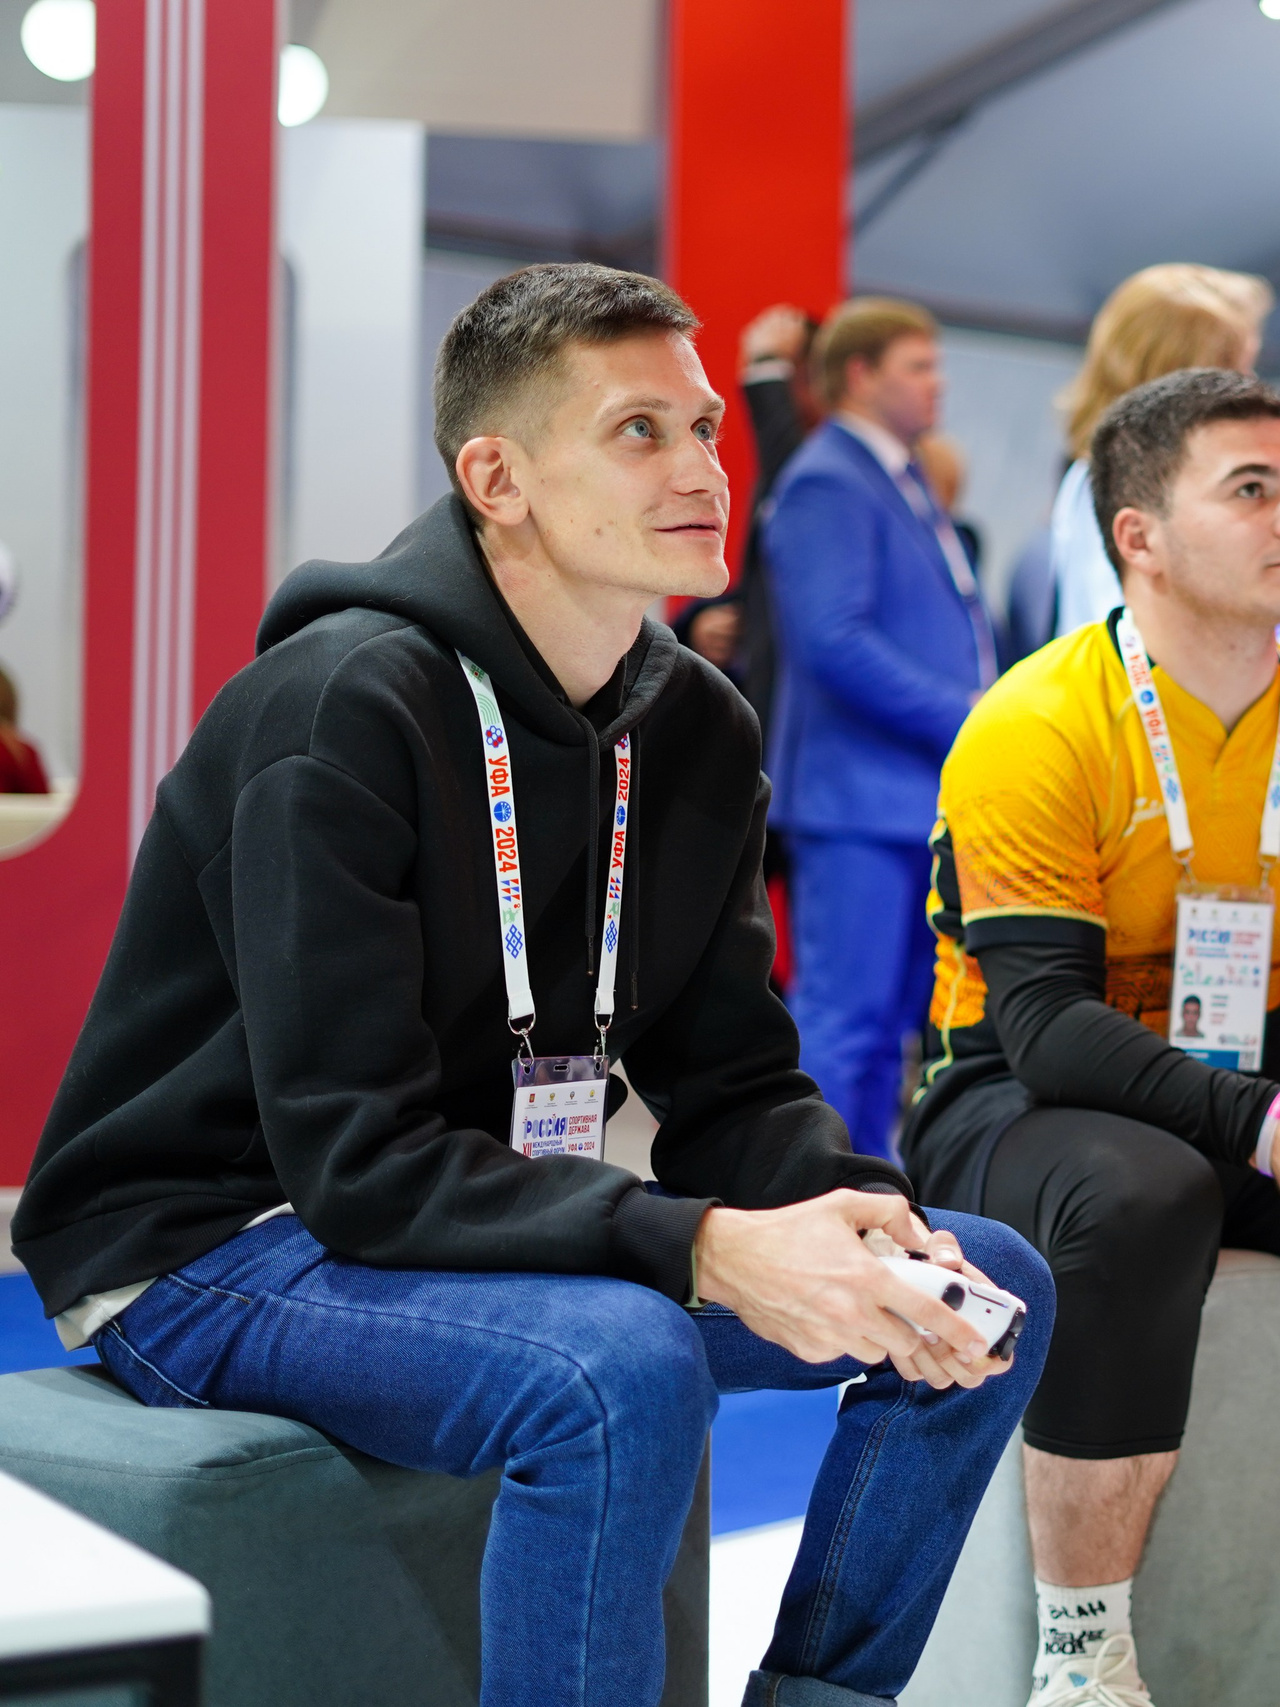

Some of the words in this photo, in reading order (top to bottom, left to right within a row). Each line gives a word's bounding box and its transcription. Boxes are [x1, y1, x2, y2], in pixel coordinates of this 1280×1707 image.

[488, 755, 510, 797] УФА
[618, 757, 630, 801] 2024
[495, 826, 518, 873] 2024
[612, 830, 625, 868] УФА
[523, 1117, 568, 1139] РОССИЯ
[568, 1114, 597, 1125] СПОРТИВНАЯ
[568, 1125, 590, 1136] ДЕРЖАВА
[568, 1143, 577, 1152] УФА
[584, 1141, 595, 1151] 2024
[1048, 1600, 1106, 1619] BLAH
